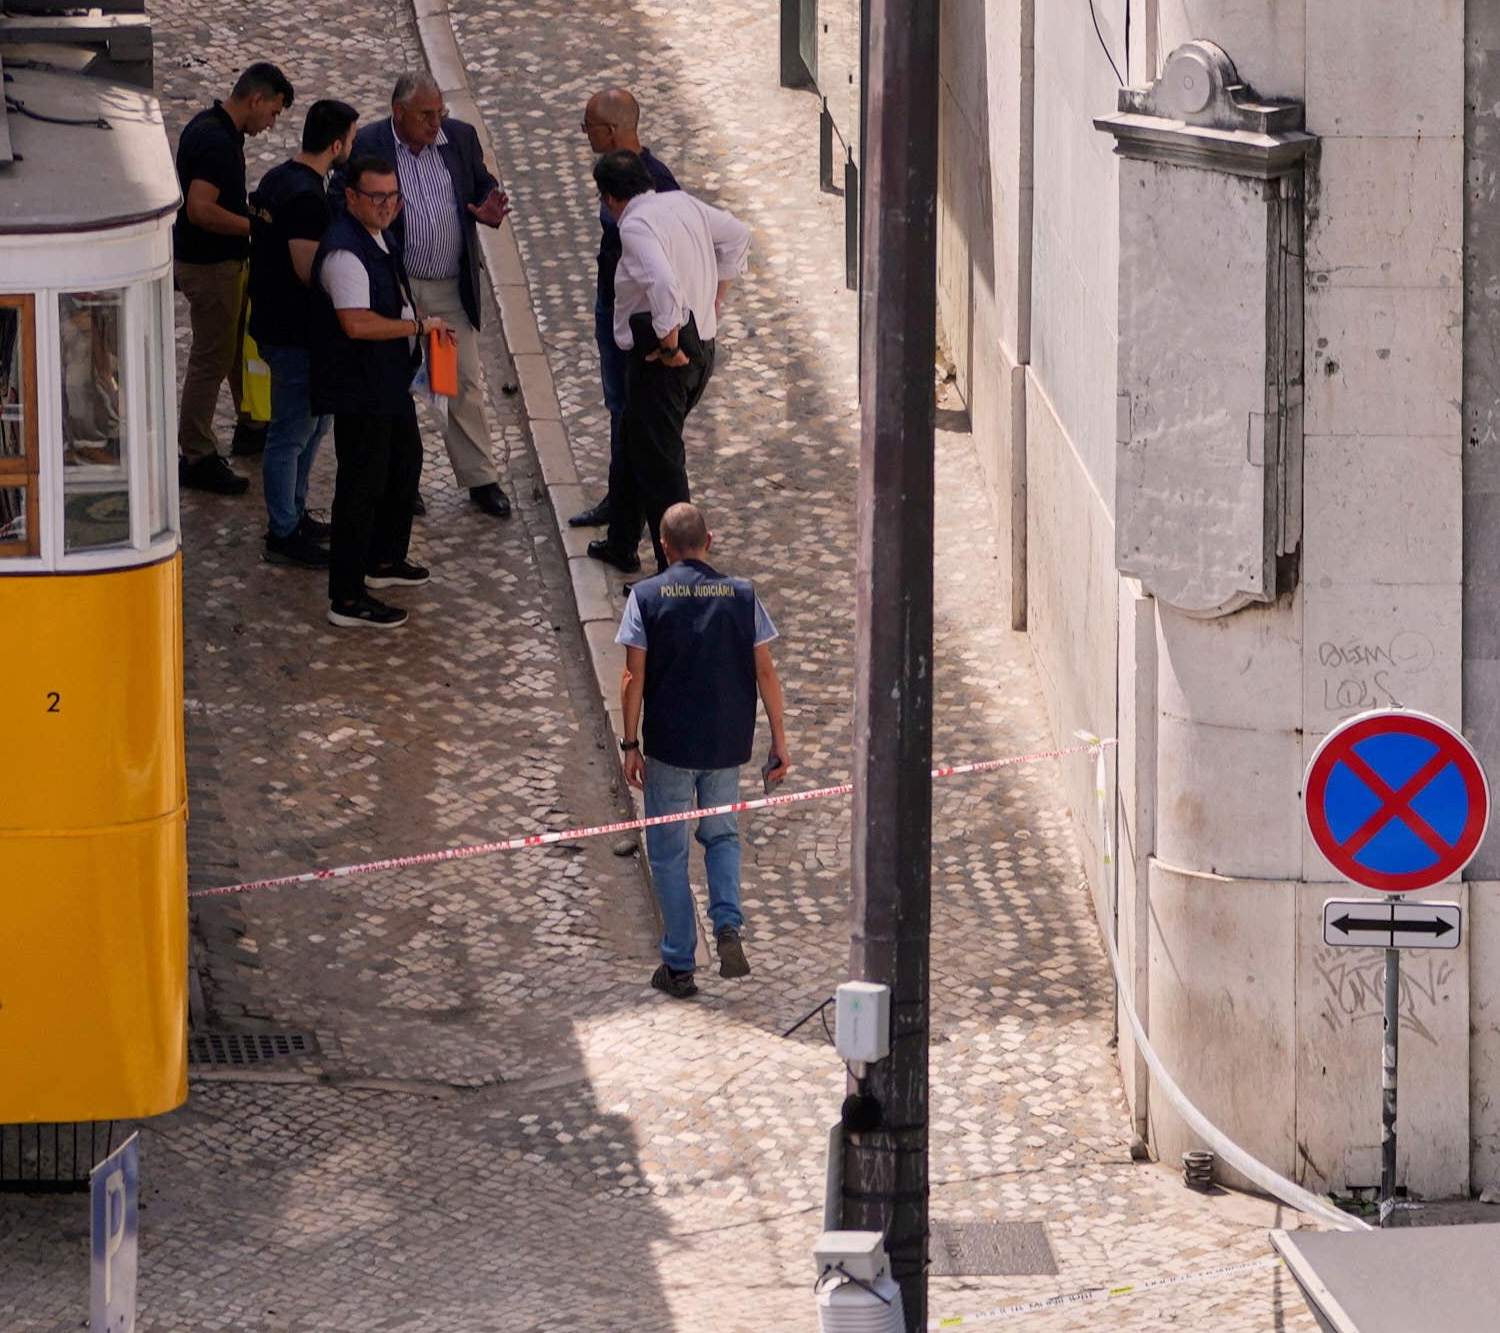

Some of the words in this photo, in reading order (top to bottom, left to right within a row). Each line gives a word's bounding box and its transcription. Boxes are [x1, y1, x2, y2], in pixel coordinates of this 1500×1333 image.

[660, 582, 692, 598] POLÍCIA
[693, 583, 735, 598] JUDICIÁRIA
[47, 691, 61, 713] 2
[104, 1167, 127, 1307] P
